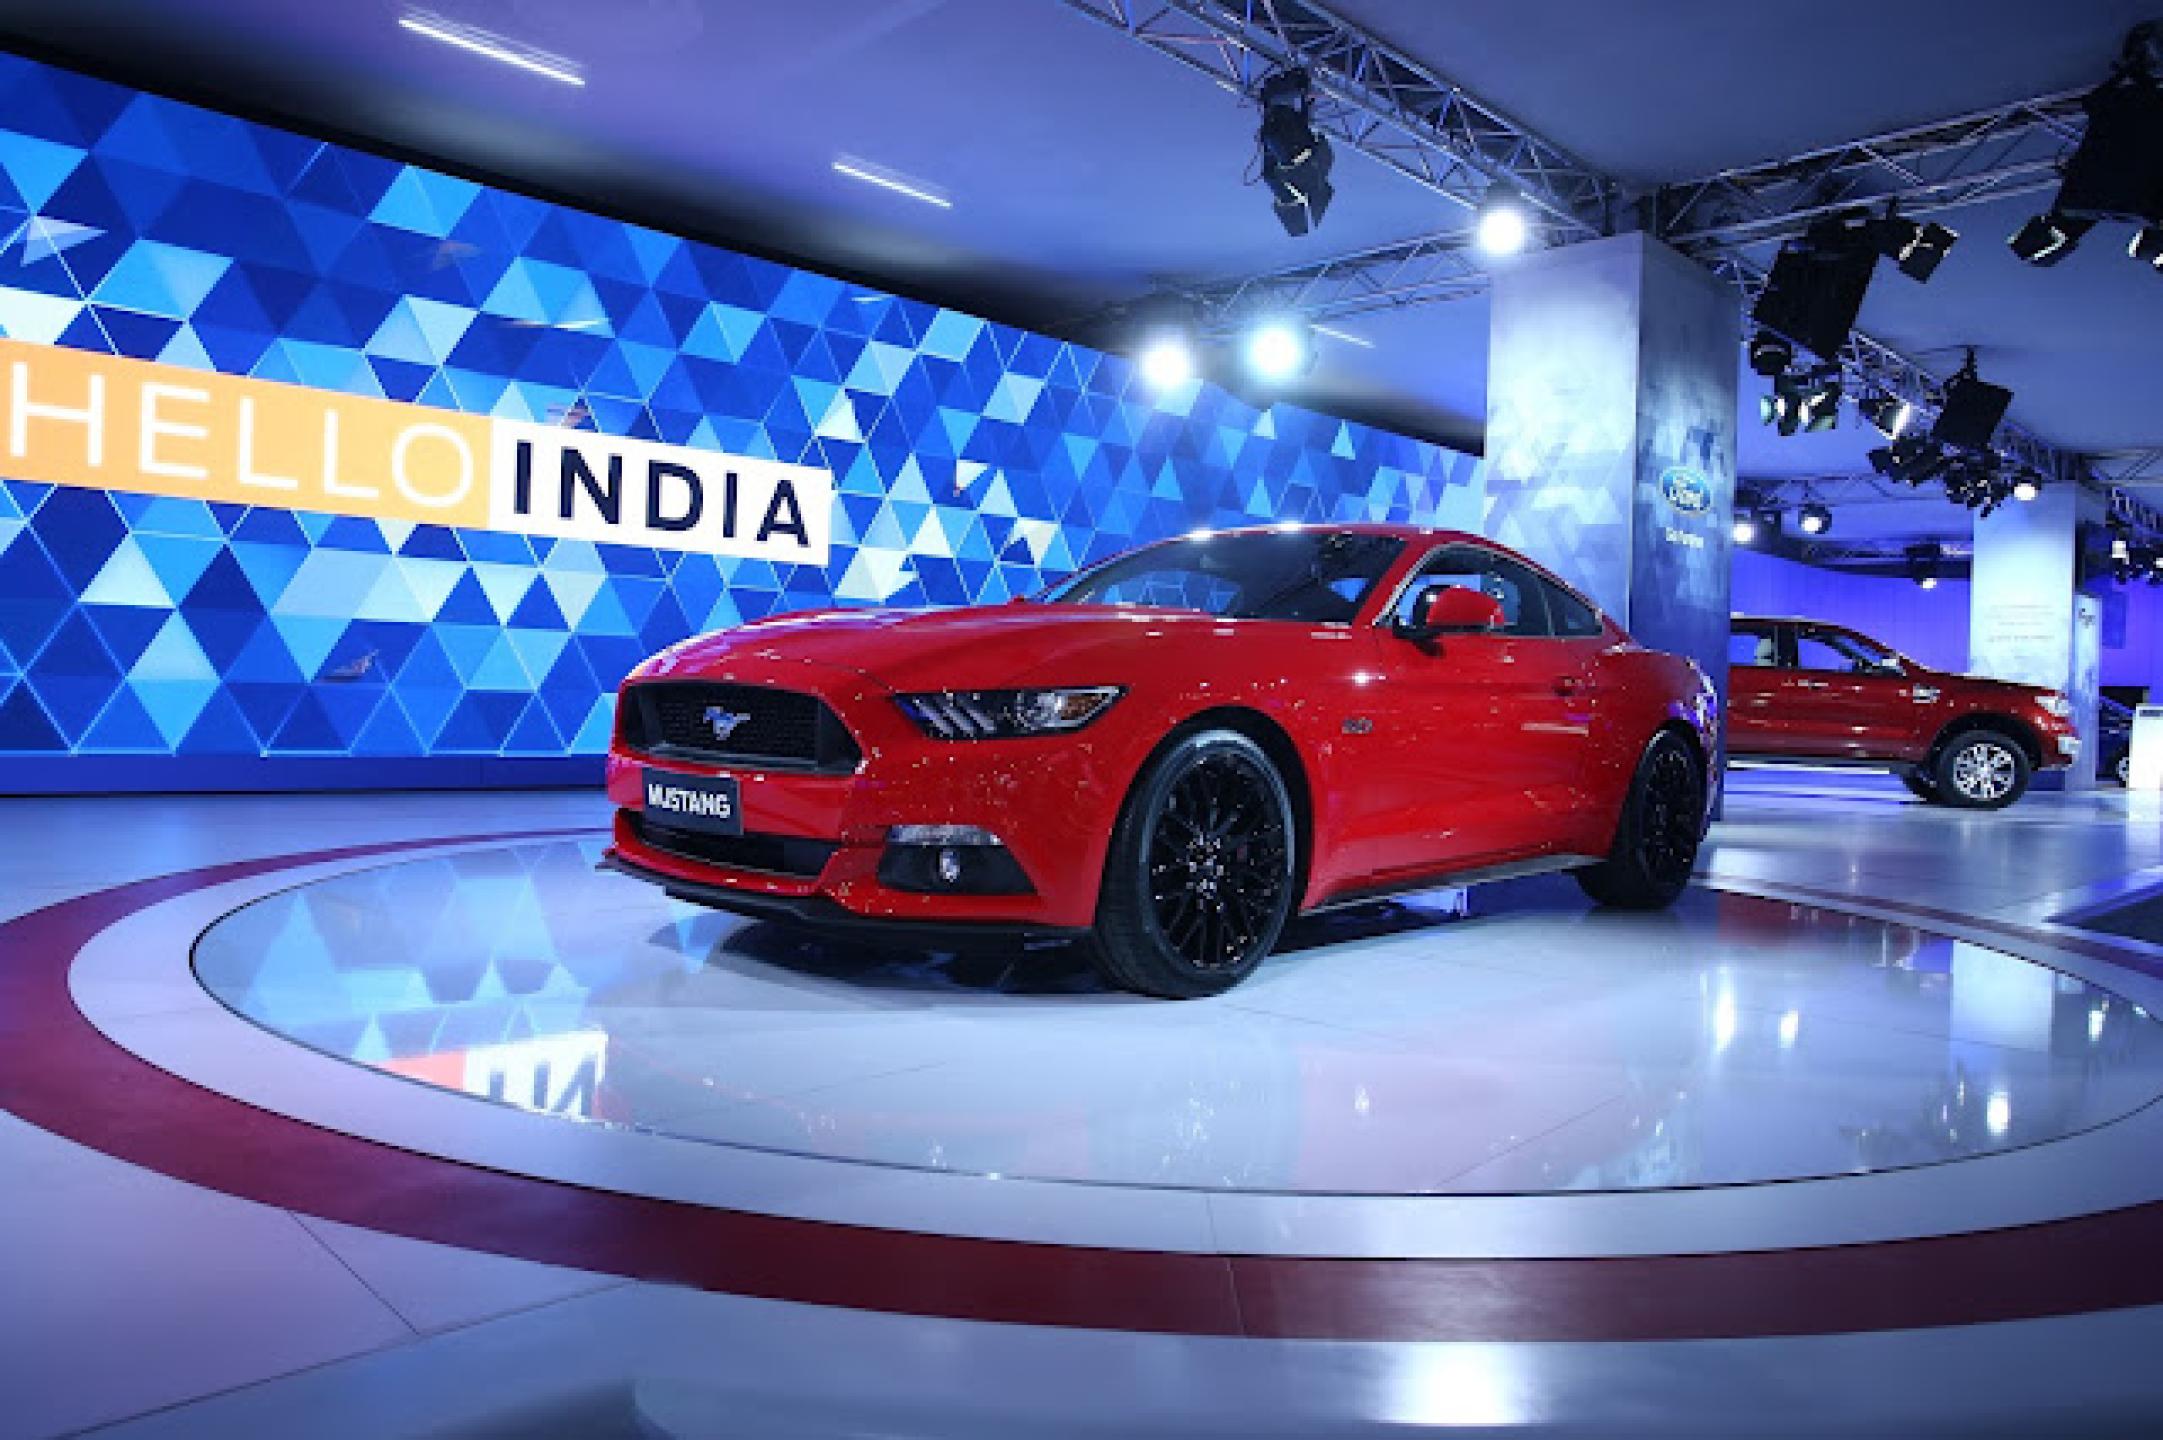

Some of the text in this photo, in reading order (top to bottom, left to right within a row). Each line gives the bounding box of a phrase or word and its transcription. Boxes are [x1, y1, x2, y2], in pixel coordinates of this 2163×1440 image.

[9, 362, 811, 548] HELLO INDIA
[648, 783, 731, 818] MUSTANG
